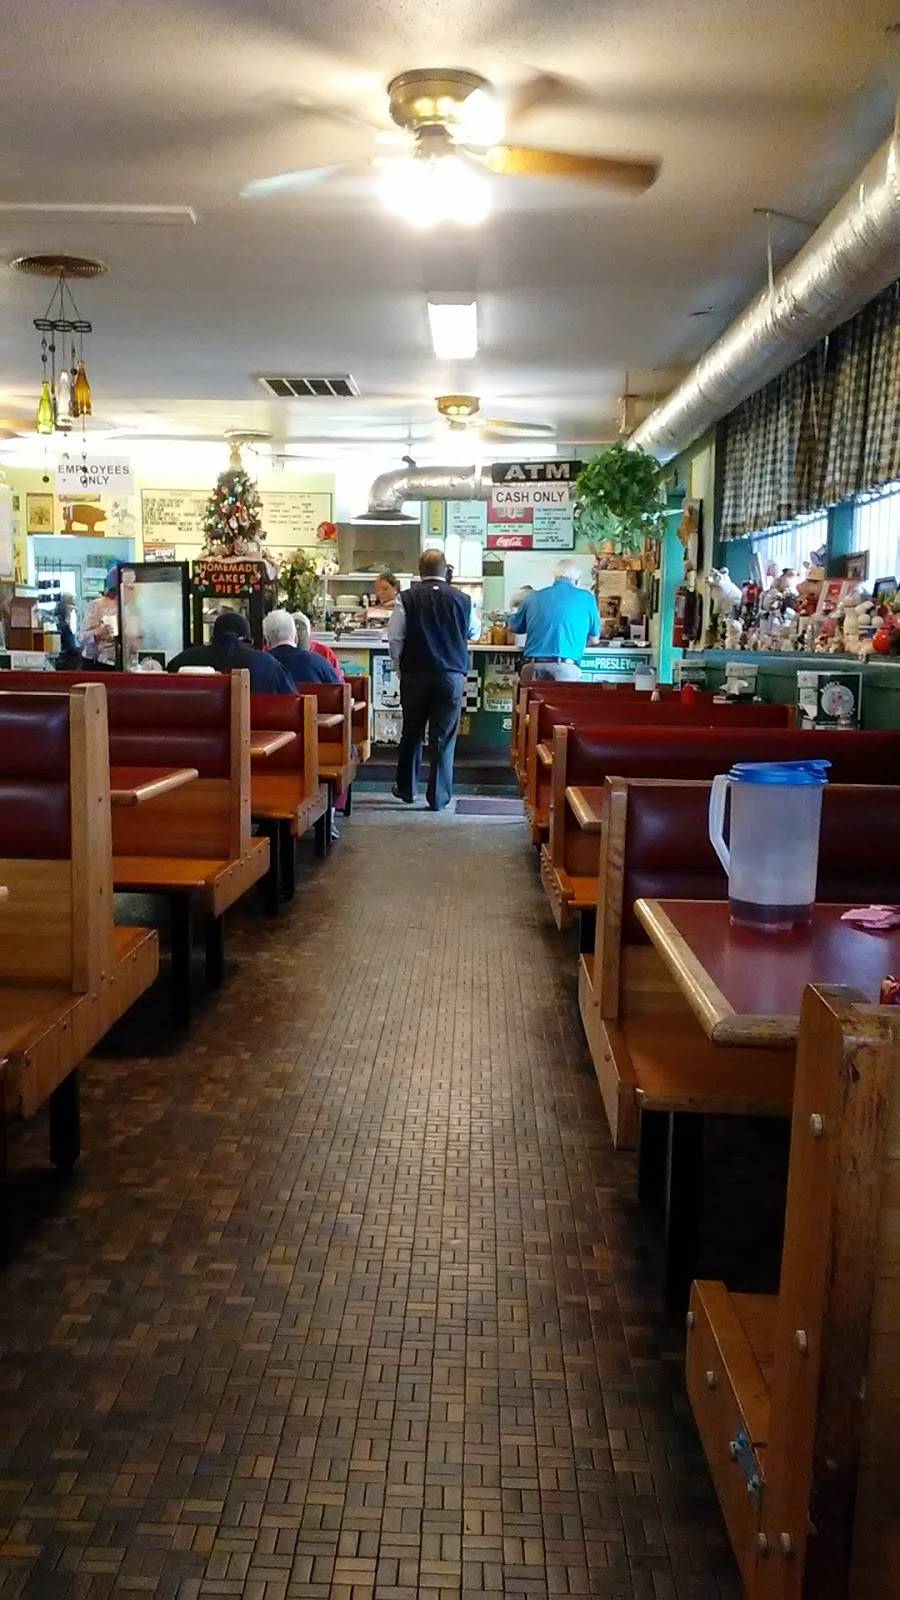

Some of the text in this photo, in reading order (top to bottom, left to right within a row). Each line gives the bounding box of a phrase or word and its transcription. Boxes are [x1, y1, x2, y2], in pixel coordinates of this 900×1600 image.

[506, 463, 570, 479] ATM
[79, 475, 110, 486] ONLY
[495, 491, 565, 503] CASH ONLY
[199, 562, 258, 572] HOMEMADE
[211, 574, 246, 584] CAKES
[215, 584, 241, 594] PIES
[594, 657, 632, 670] PRESLEY
